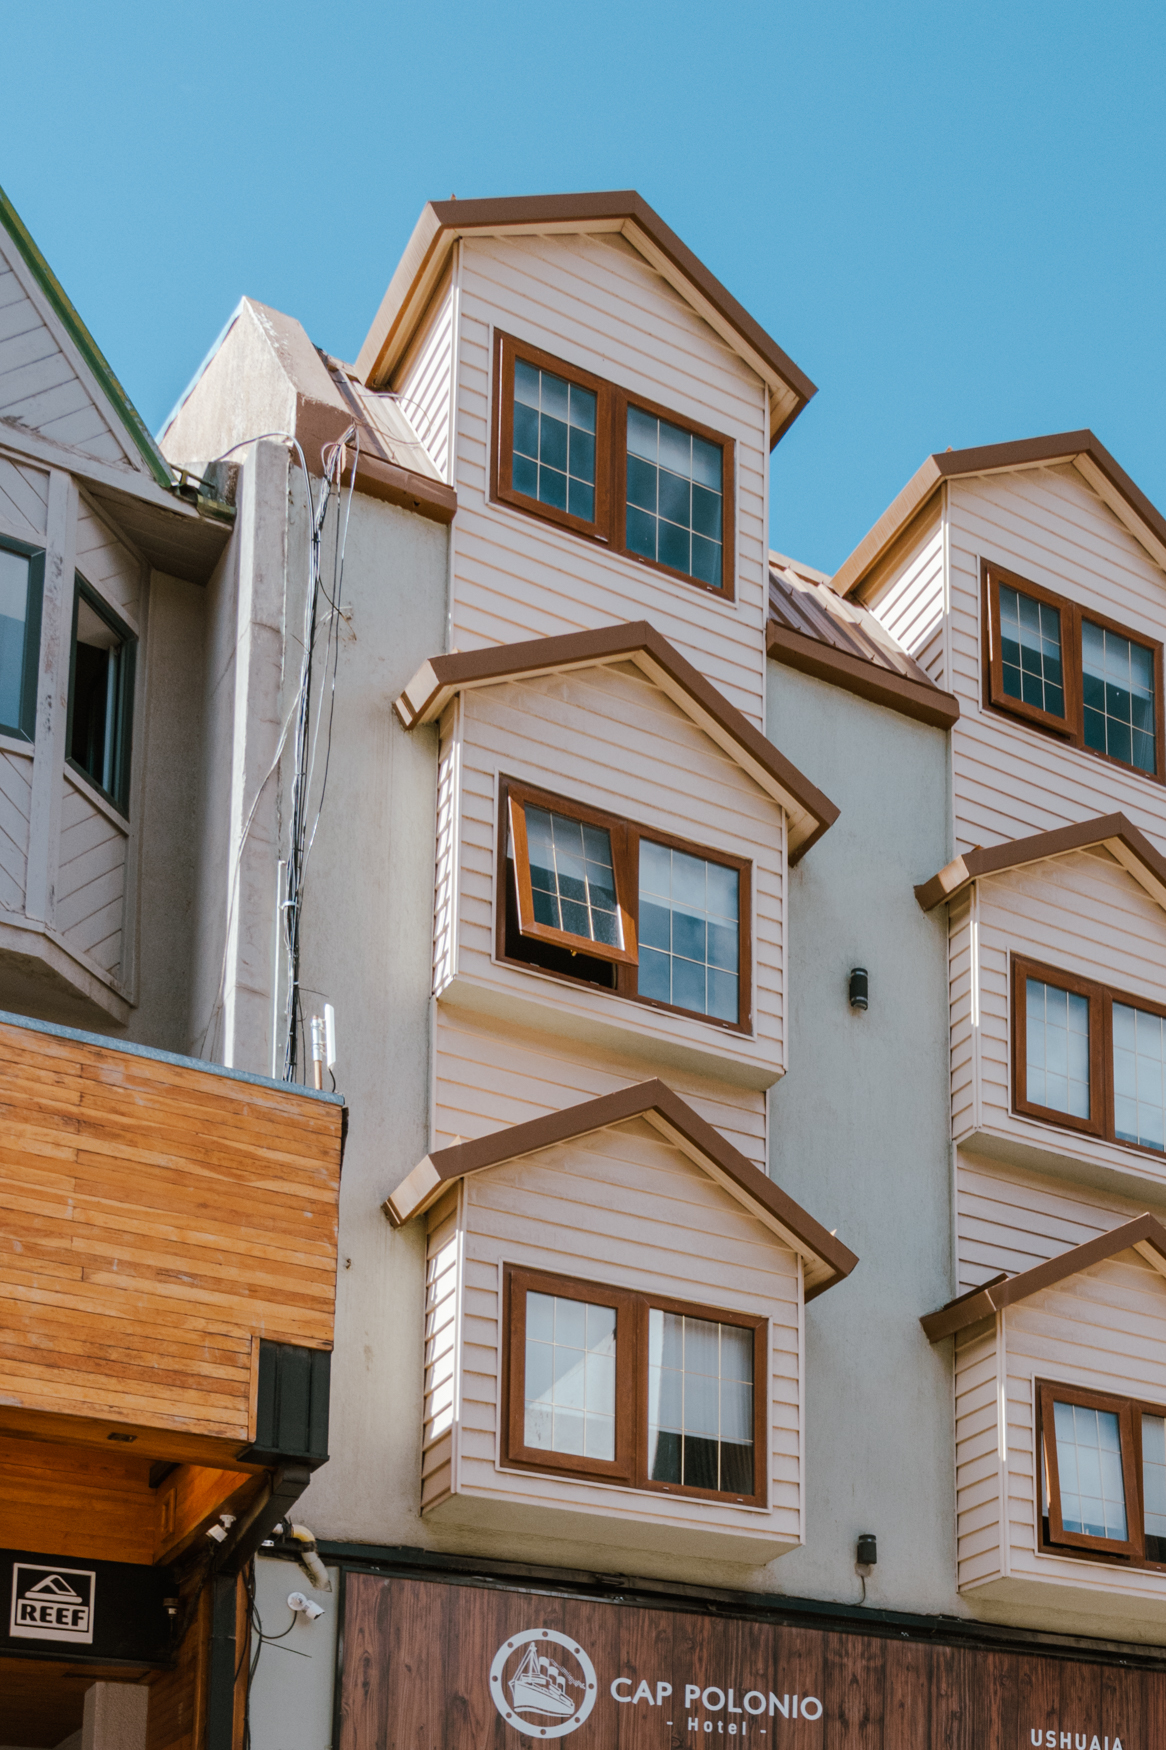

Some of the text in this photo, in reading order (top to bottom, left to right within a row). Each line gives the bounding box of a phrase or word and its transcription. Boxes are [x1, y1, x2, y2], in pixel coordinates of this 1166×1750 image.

[20, 1603, 86, 1627] REEF
[610, 1677, 823, 1721] CAP POLONIO
[687, 1717, 747, 1736] Hotel
